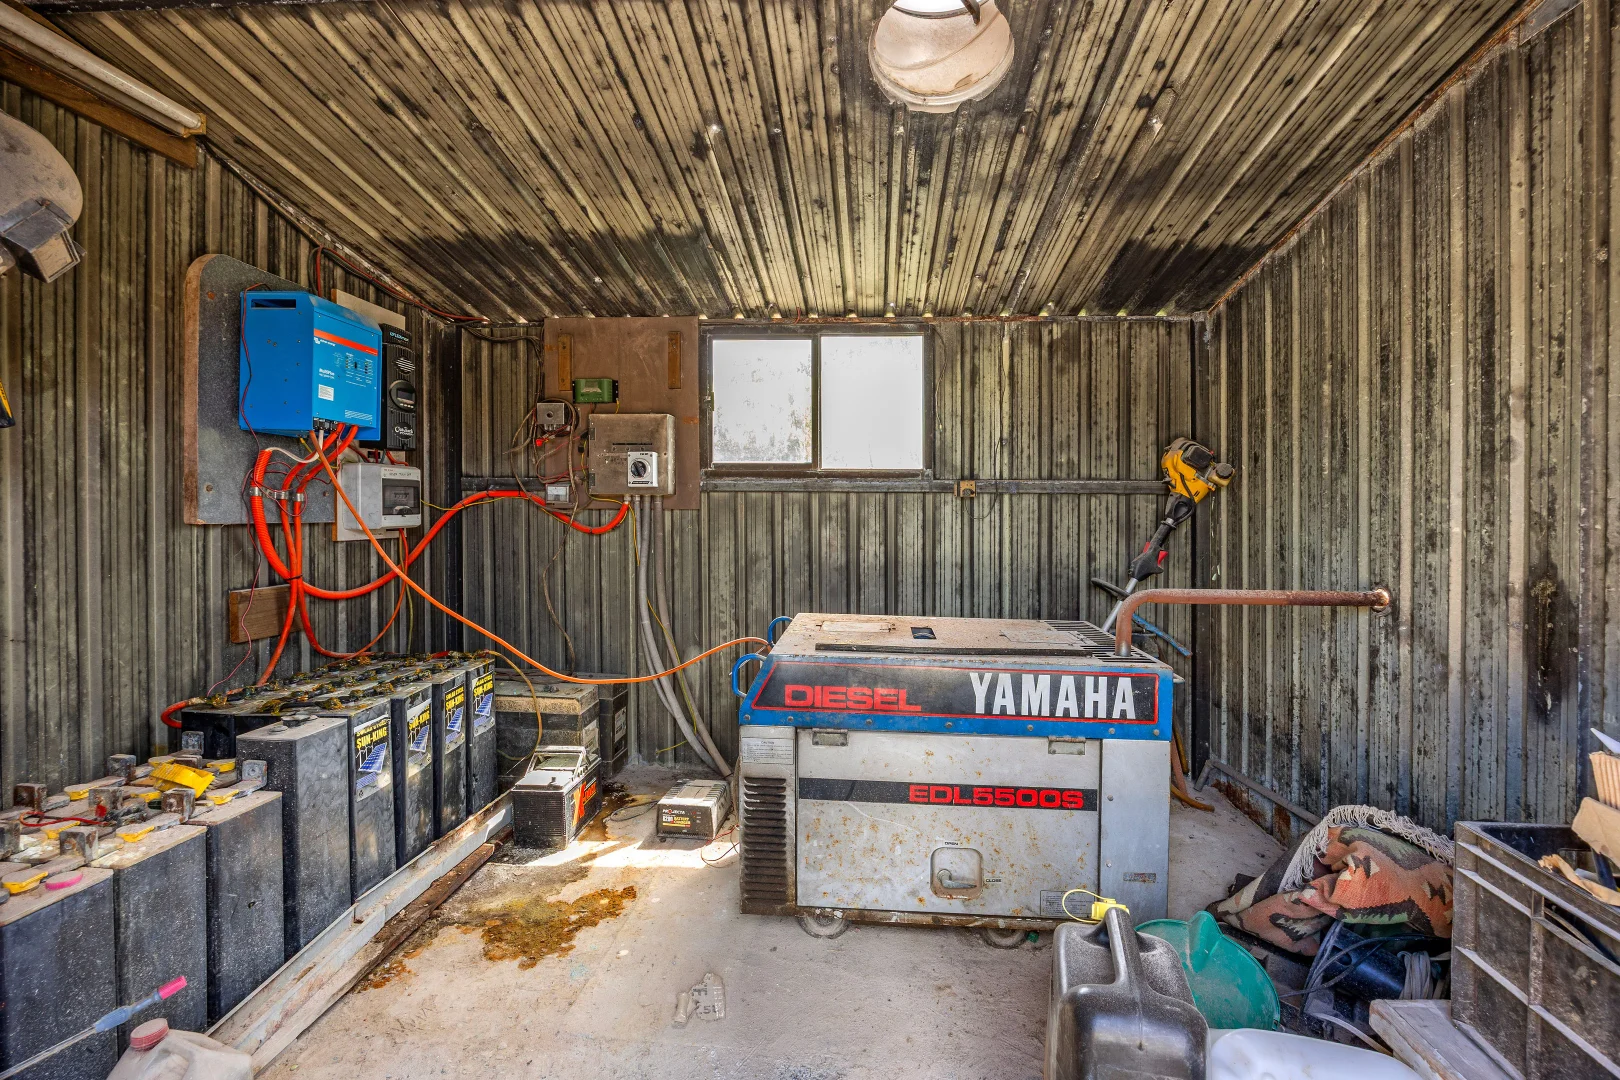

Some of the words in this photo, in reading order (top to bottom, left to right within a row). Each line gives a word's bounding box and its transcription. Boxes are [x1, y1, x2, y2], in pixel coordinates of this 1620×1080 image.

[785, 684, 922, 712] DIESEL
[969, 672, 1136, 720] YAMAHA
[356, 726, 388, 749] SUN-KING
[909, 784, 1084, 809] EDL5500S
